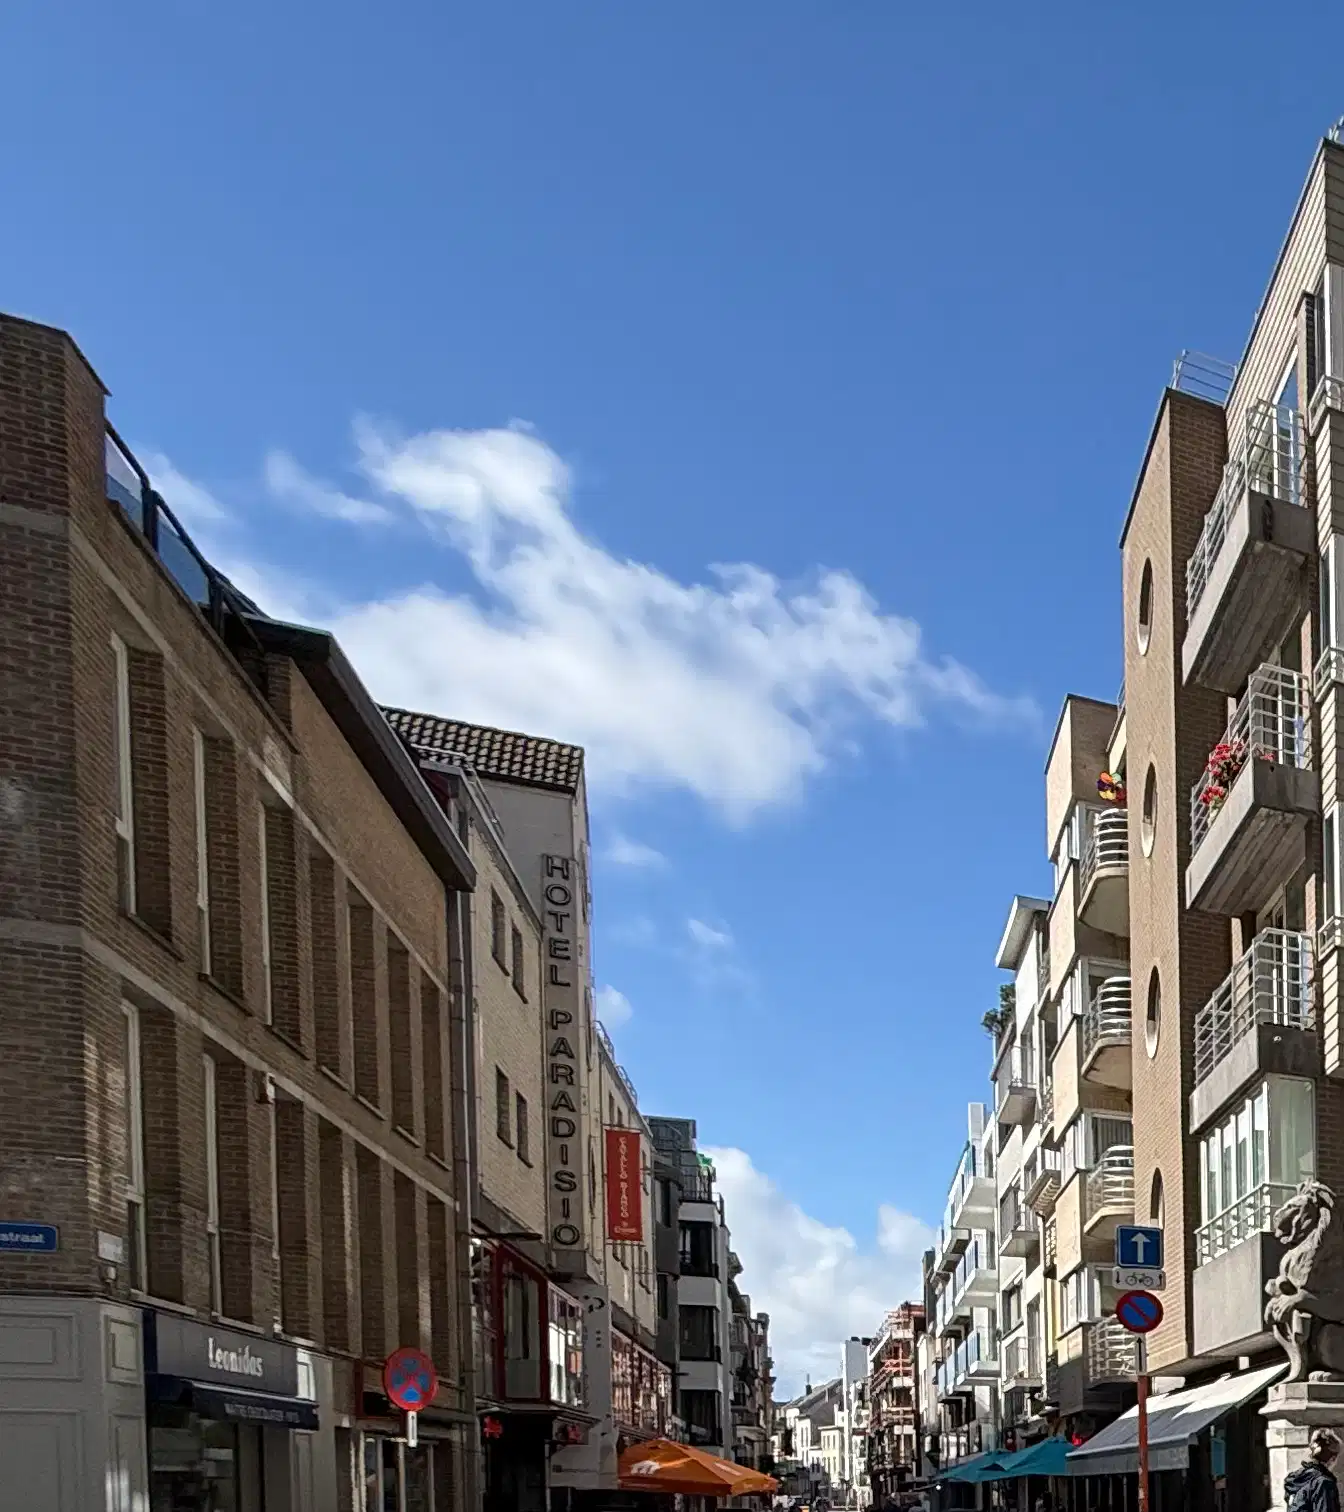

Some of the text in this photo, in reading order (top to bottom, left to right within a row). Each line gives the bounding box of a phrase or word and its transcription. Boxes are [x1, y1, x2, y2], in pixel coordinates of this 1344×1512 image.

[546, 855, 580, 1247] HOTEL PARADISIO
[208, 1337, 263, 1377] Leonidas
